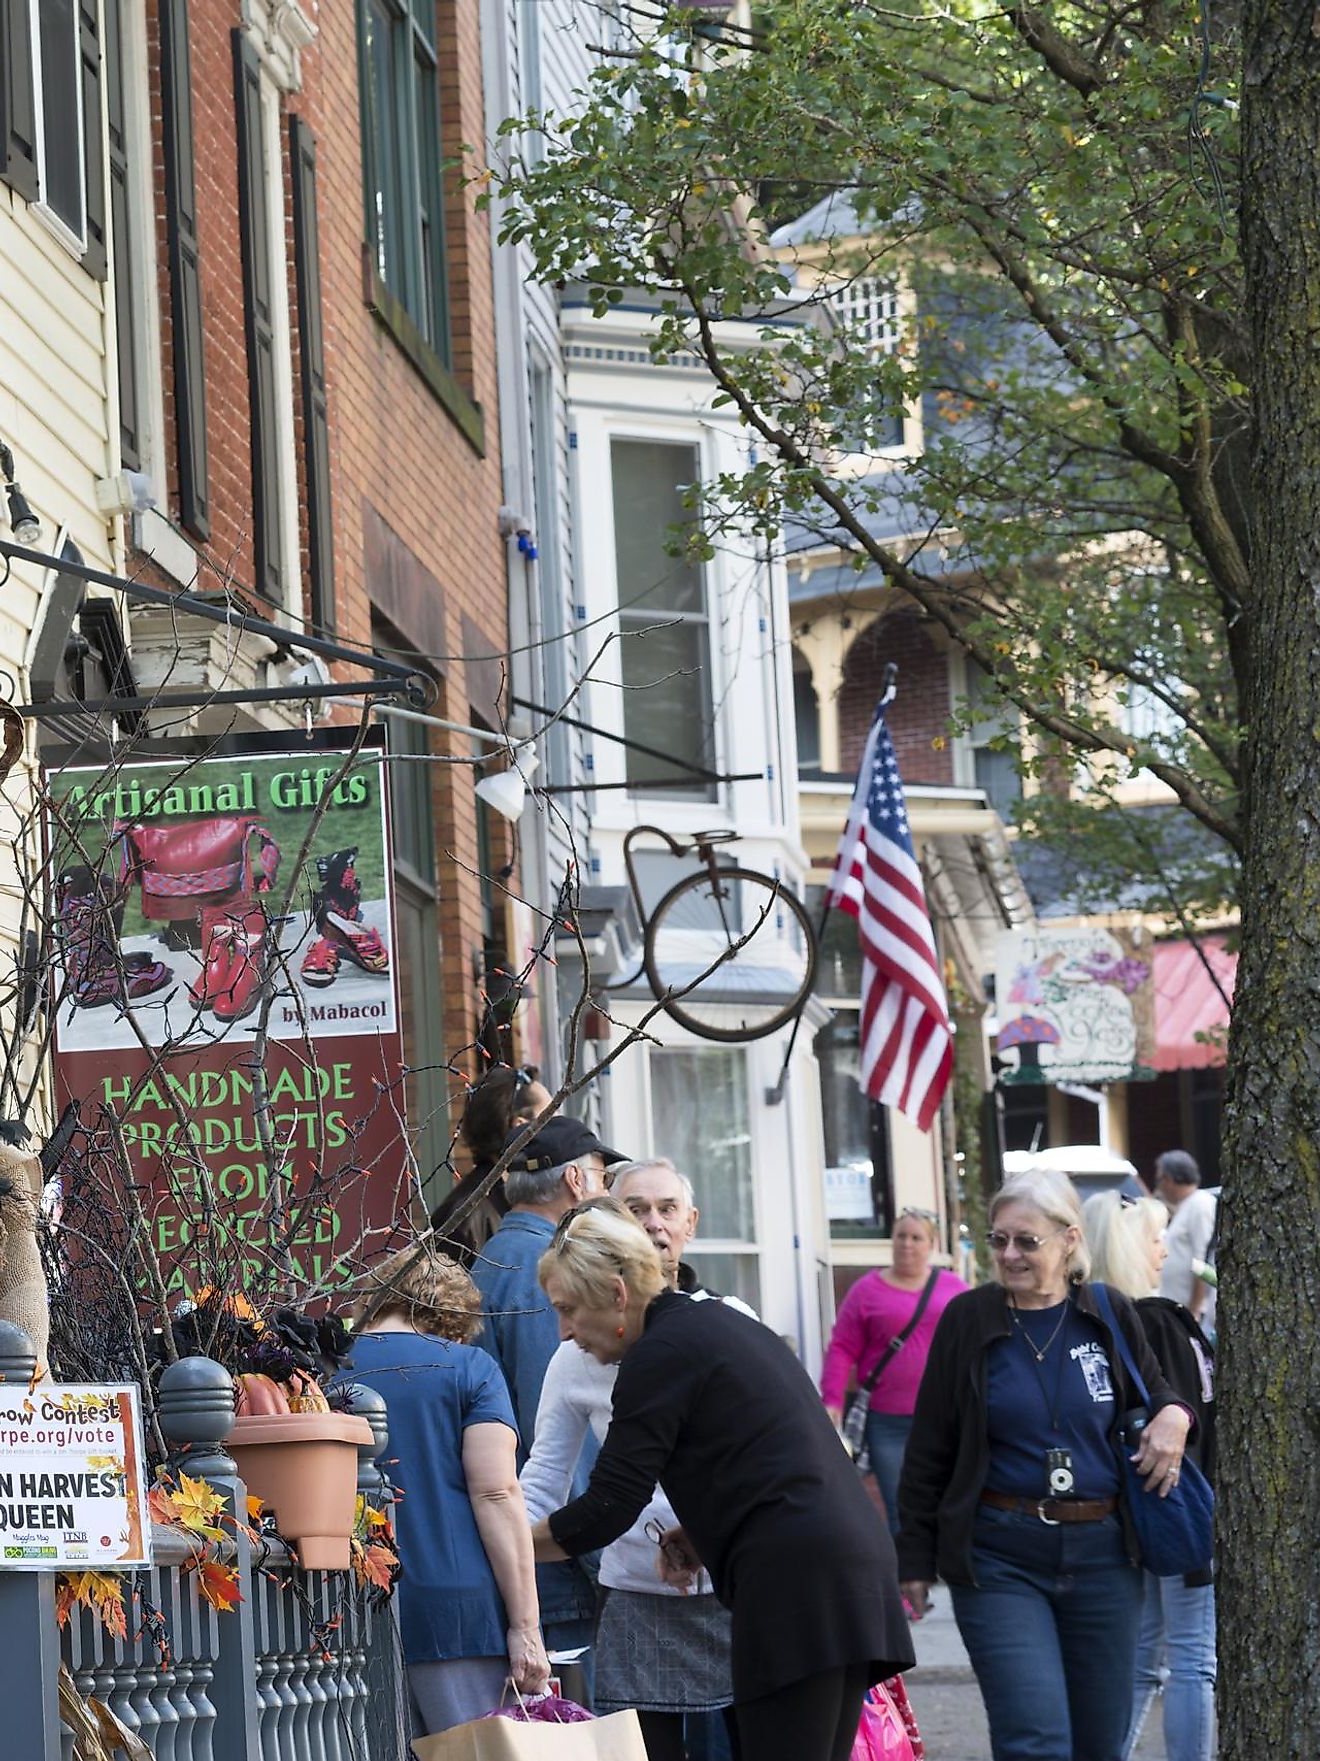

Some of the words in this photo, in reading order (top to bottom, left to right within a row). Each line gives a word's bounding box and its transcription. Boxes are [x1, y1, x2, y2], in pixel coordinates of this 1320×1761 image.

[67, 771, 257, 821] Artisanal
[269, 767, 367, 809] Gifts
[281, 1006, 302, 1027] by
[309, 1000, 387, 1022] Mabacol
[101, 1063, 356, 1112] HANDMADE
[41, 1398, 121, 1425] Contest
[20, 1471, 127, 1498] HARVEST
